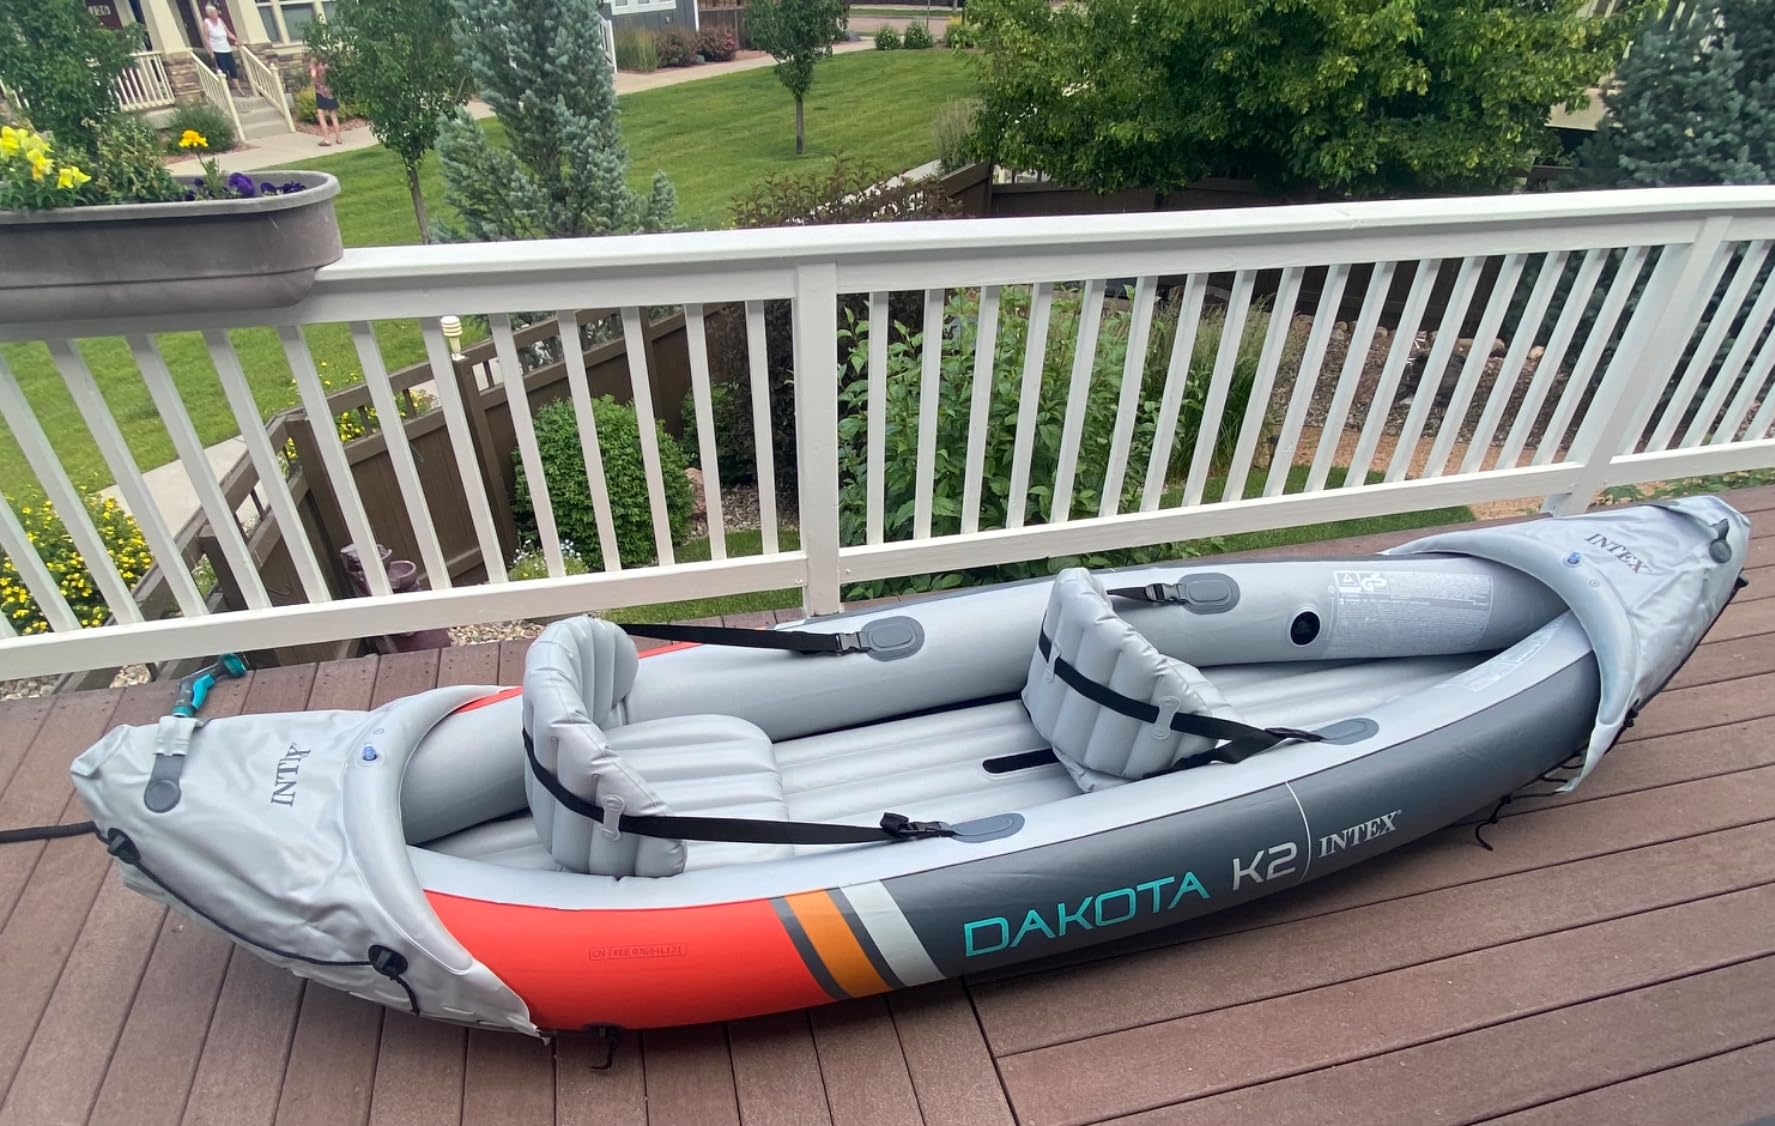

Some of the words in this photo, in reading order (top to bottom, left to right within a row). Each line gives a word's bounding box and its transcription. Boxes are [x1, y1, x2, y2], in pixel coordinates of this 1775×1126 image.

[1584, 533, 1648, 573] INTEX
[1317, 810, 1401, 858] INTEX
[963, 871, 1211, 957] DAKOTA
[1232, 842, 1298, 890] K2
